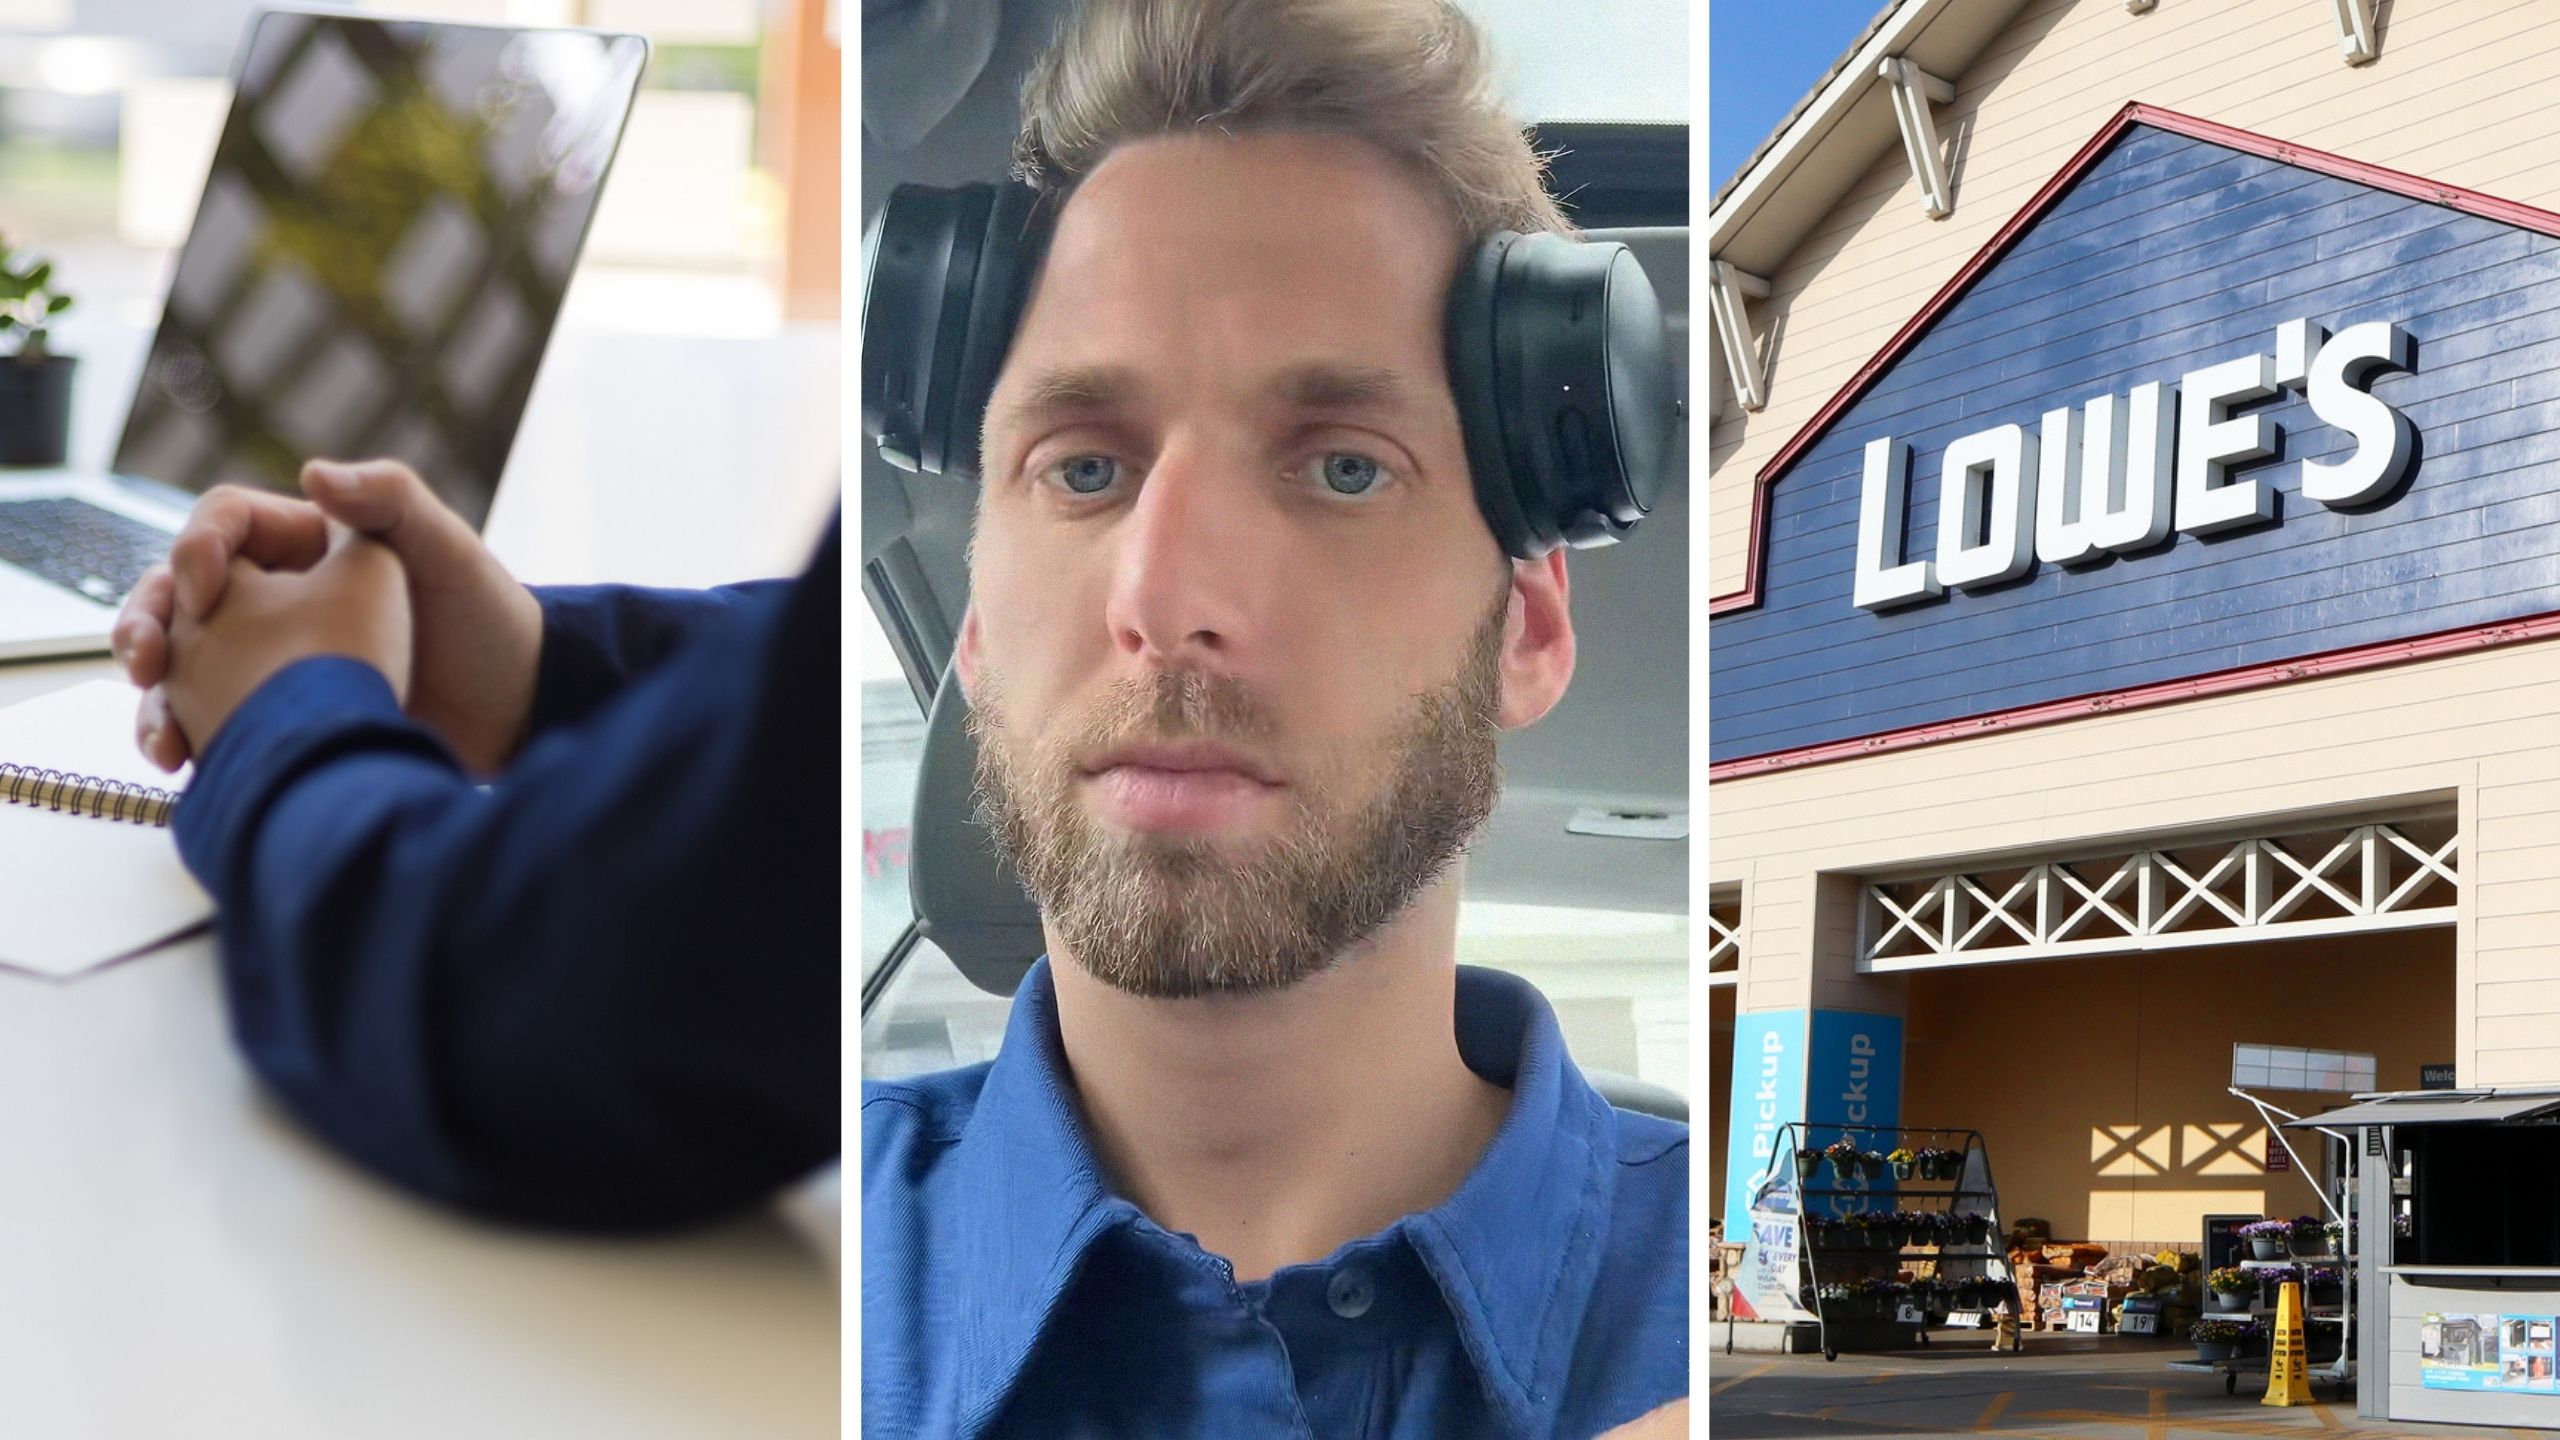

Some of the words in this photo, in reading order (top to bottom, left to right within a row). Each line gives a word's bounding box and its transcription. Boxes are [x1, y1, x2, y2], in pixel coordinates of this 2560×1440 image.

[1853, 317, 2417, 612] LOWE'S
[1753, 1030, 1784, 1159] Pickup
[2079, 1313, 2093, 1328] 14
[2133, 1316, 2147, 1330] 19
